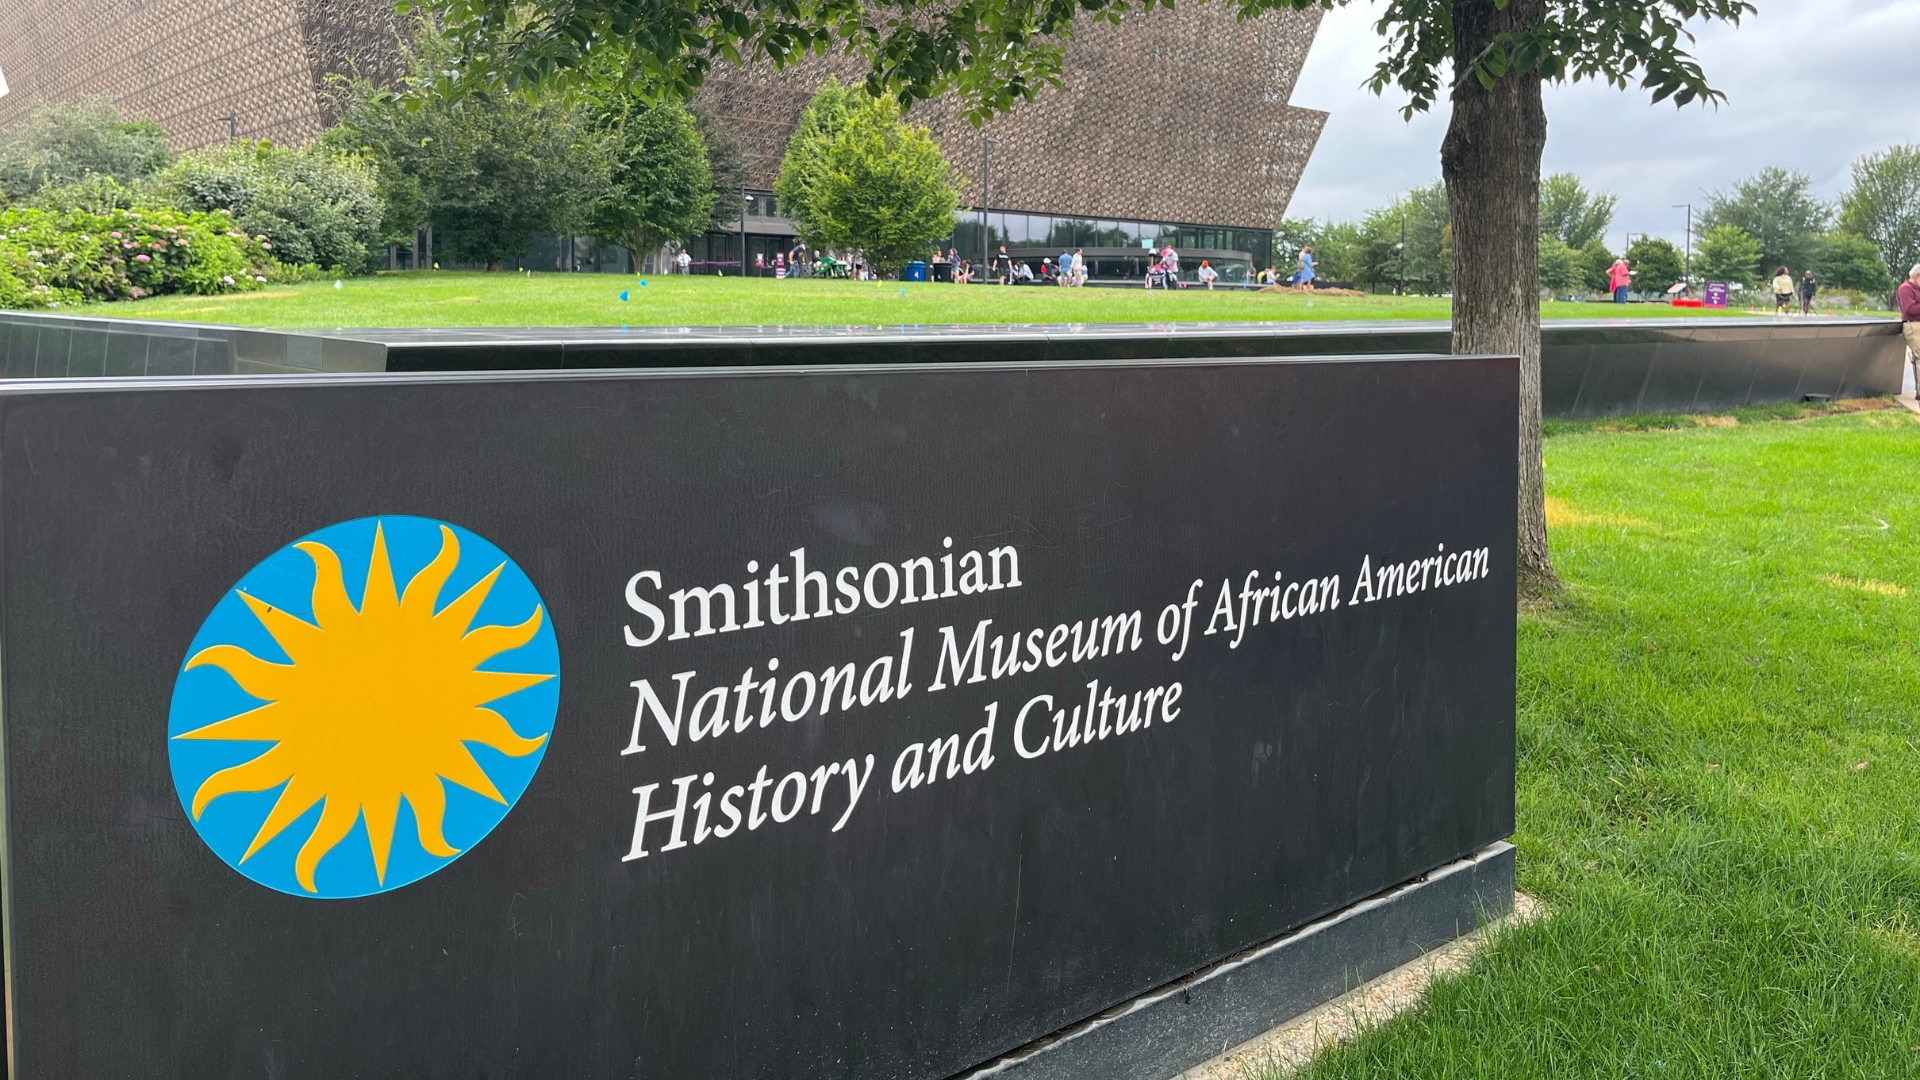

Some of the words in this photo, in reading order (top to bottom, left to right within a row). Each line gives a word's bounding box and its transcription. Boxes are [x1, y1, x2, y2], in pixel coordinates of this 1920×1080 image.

[620, 626, 915, 756] National
[927, 609, 1143, 692] Museum
[1157, 578, 1204, 662] of
[1203, 569, 1340, 650] African
[1348, 542, 1489, 606] American
[623, 536, 1023, 647] Smithsonian
[621, 753, 875, 863] History
[891, 700, 998, 794] and
[1013, 678, 1183, 759] Culture
